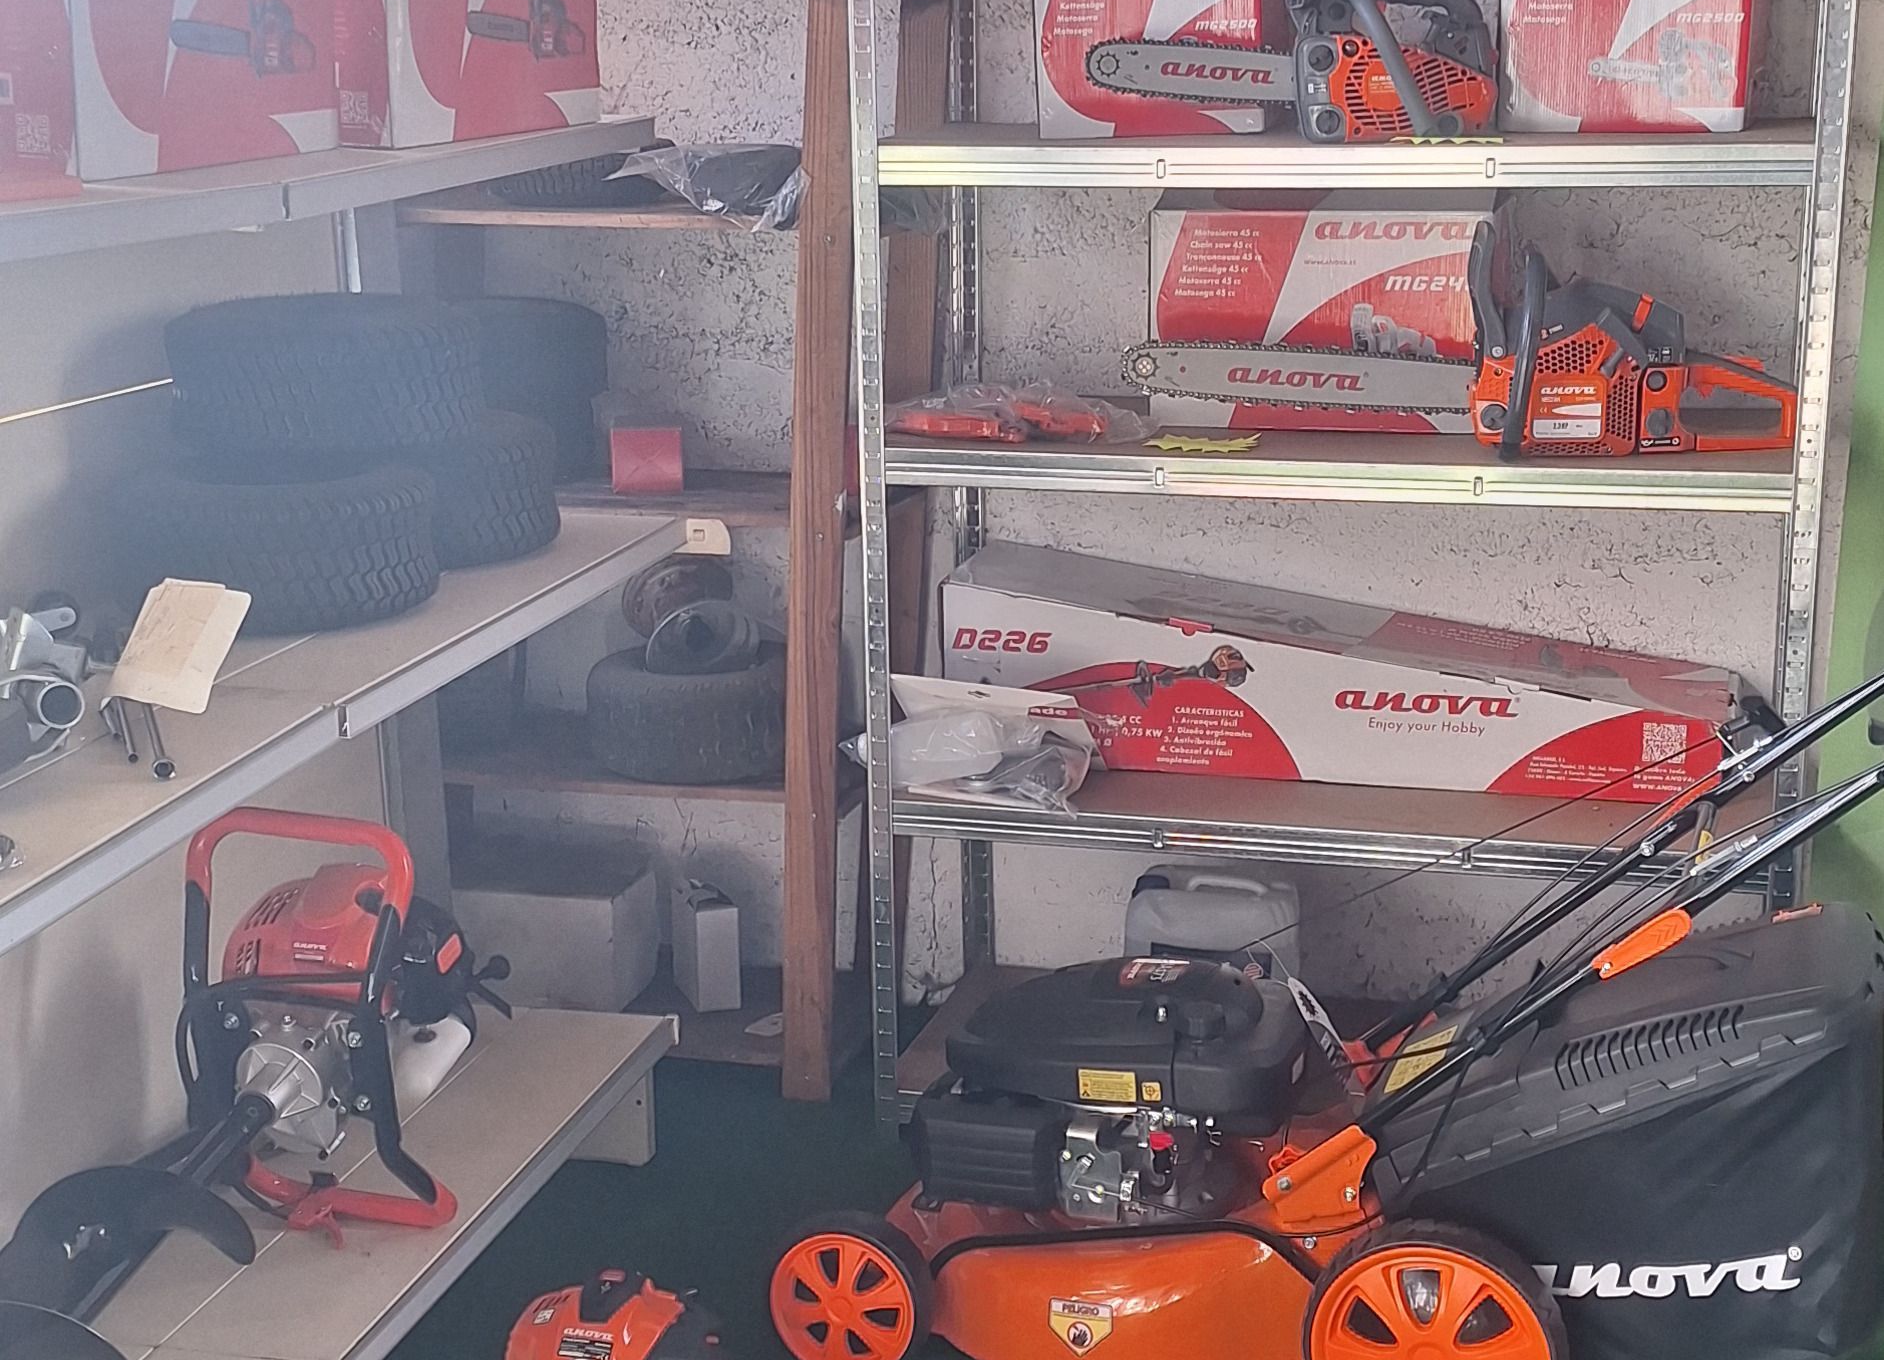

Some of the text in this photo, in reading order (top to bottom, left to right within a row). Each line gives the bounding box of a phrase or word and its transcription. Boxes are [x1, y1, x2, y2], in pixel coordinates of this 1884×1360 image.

[1160, 61, 1275, 85] anova
[1315, 220, 1473, 240] anova
[1385, 275, 1469, 291] MG24
[1227, 366, 1365, 390] anova
[951, 628, 1053, 654] D226
[1334, 688, 1519, 718] anova
[1145, 728, 1163, 738] KW
[1367, 716, 1486, 737] Enjoy your Hobby
